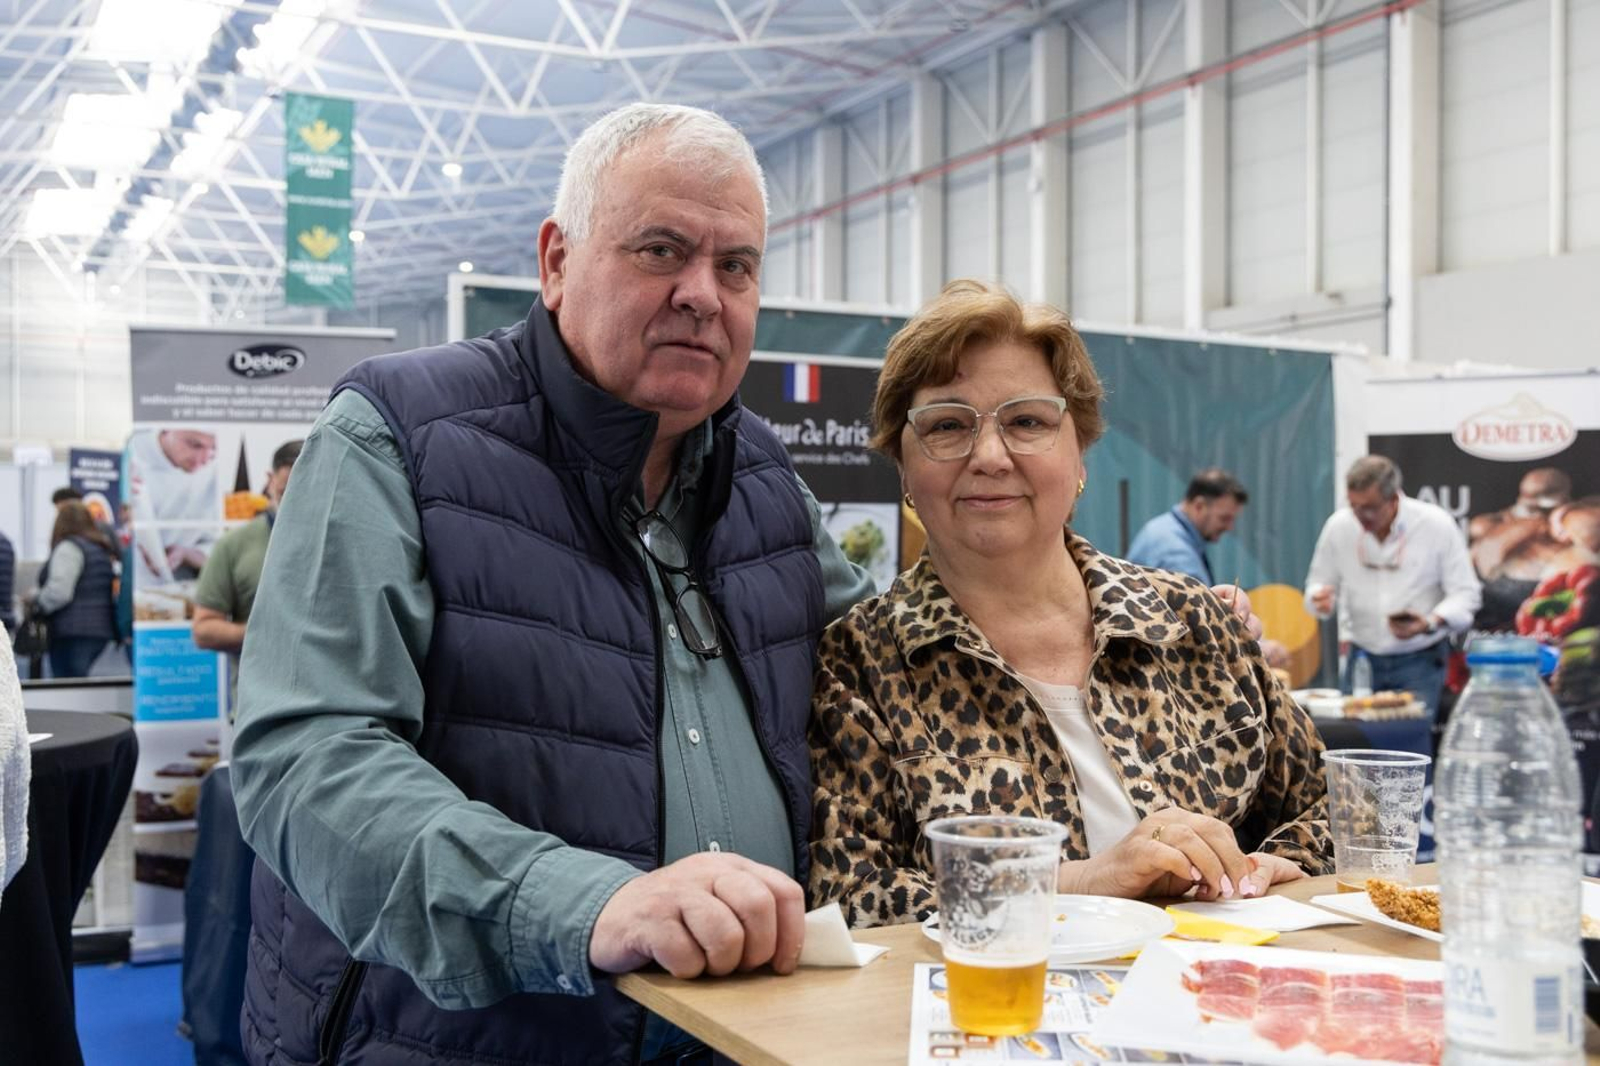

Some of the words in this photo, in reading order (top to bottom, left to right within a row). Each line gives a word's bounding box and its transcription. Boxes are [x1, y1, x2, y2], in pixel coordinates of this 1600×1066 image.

[234, 349, 296, 372] Debic
[826, 419, 870, 447] Paris
[1461, 422, 1569, 446] DEMETRA
